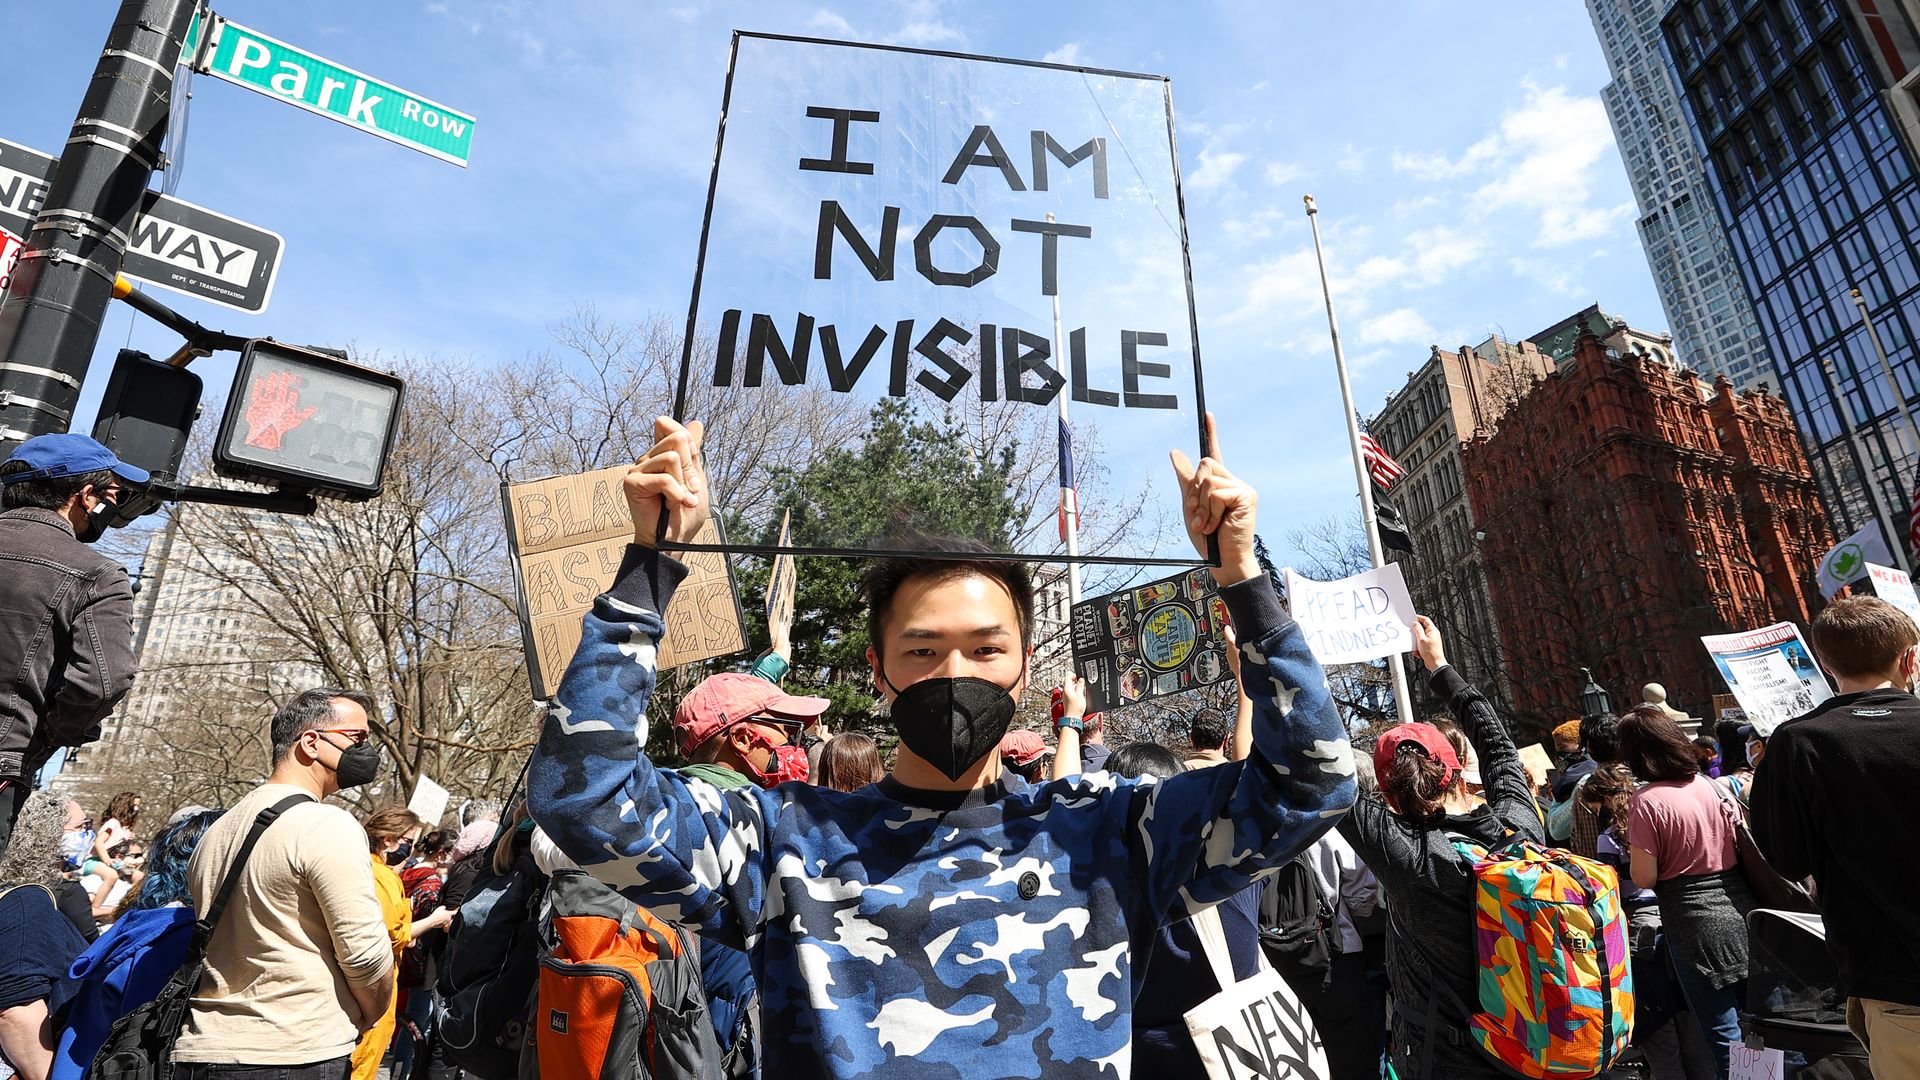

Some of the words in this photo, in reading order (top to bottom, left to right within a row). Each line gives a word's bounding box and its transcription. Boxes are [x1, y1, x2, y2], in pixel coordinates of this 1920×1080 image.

[228, 36, 387, 129] Park
[800, 106, 880, 175] I
[941, 125, 1109, 200] AM
[0, 176, 51, 218] NE
[131, 221, 245, 275] WAY
[814, 199, 1091, 296] NOT
[199, 281, 246, 300] TRANSPORTATION
[713, 308, 1178, 409] INVISIBLE
[519, 478, 634, 547] BLA
[1072, 607, 1088, 650] EARTH
[1082, 604, 1098, 647] PLANET
[1152, 611, 1170, 666] EARTH
[1166, 608, 1182, 662] PLANET
[1303, 621, 1401, 656] KINDNESS
[1744, 626, 1794, 647] REVOLUTION
[1749, 658, 1768, 667] FIGHT
[1753, 674, 1772, 683] FIGHT
[1731, 1045, 1760, 1072] STOP
